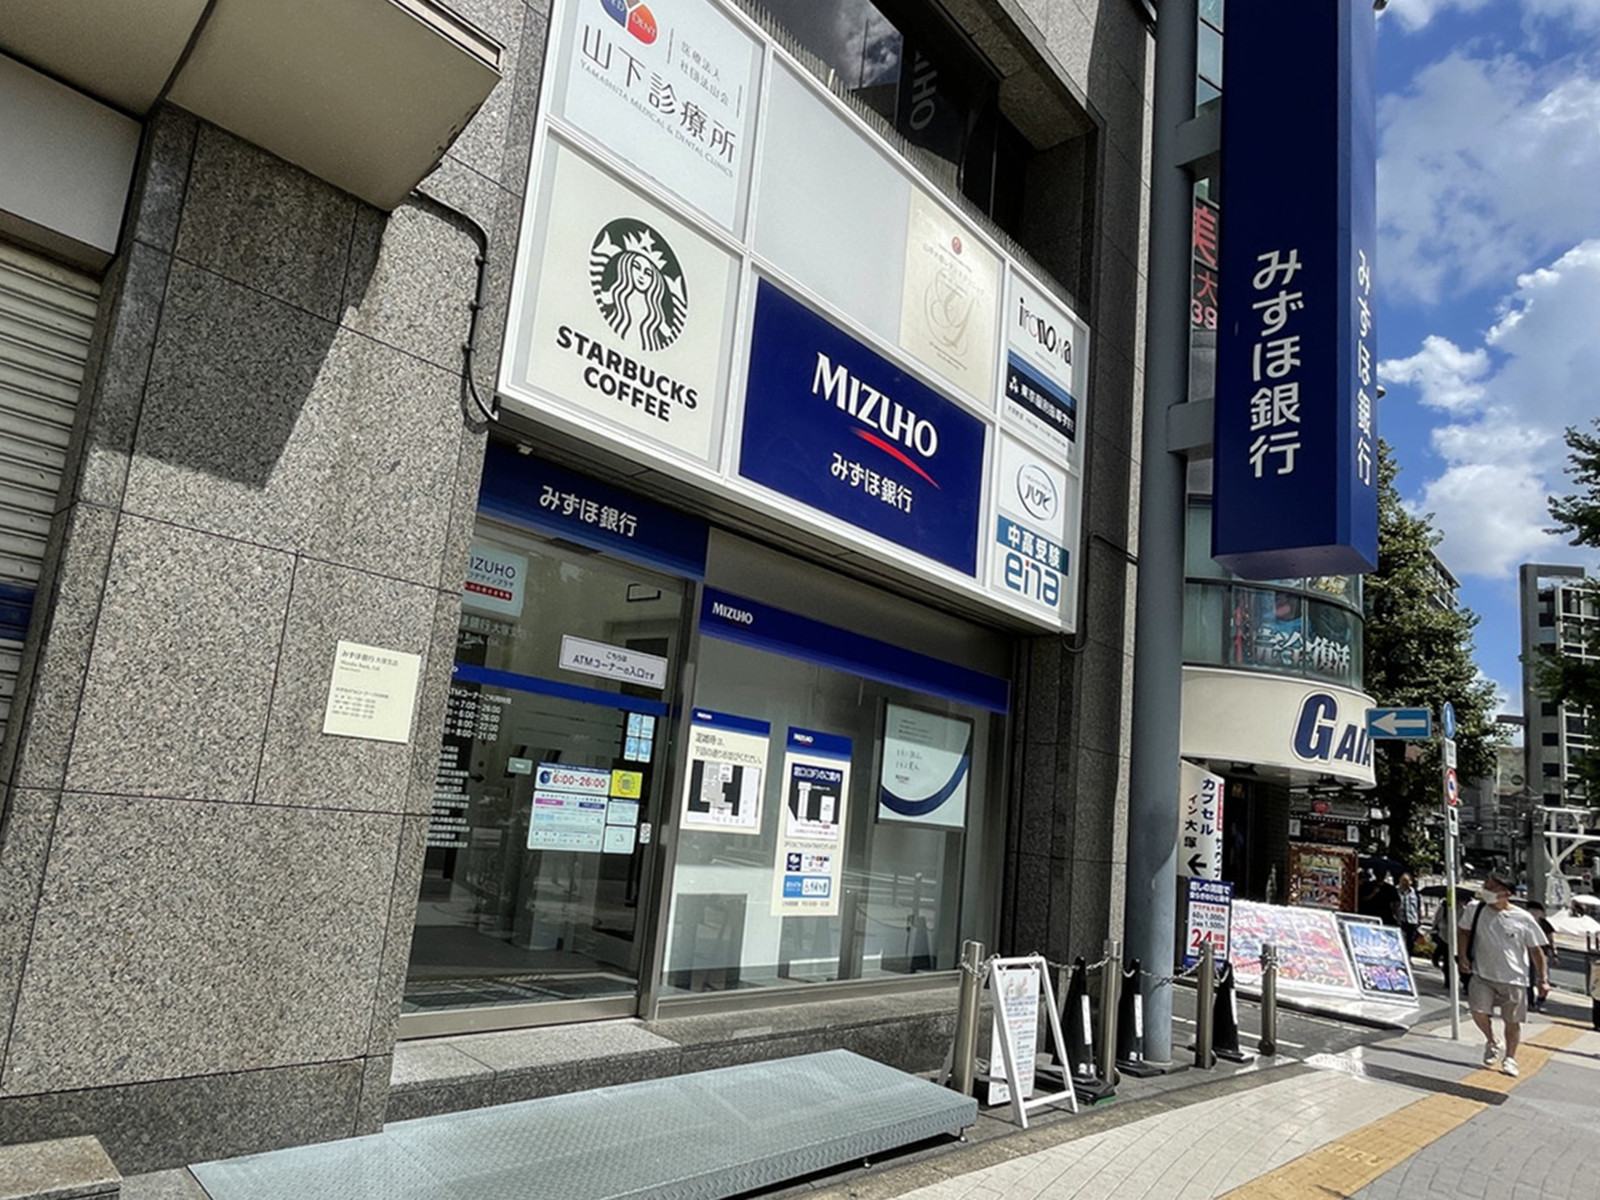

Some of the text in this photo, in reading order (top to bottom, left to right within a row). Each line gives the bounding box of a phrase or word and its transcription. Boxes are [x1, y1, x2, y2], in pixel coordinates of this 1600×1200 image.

[579, 58, 630, 103] YAMASHITA
[629, 96, 667, 132] MEDICAL
[674, 129, 704, 157] DENTAL
[582, 24, 737, 163] 山下診療所
[555, 325, 699, 410] STARBUCKS
[1249, 247, 1305, 479] みずほ銀行
[582, 366, 672, 423] COFFEE
[811, 351, 940, 458] MIZUHO
[539, 484, 639, 538] みずほ銀行
[830, 451, 914, 514] みずほ銀行
[469, 555, 517, 580] IZUHO
[1004, 551, 1060, 608] ena
[711, 601, 754, 625] MIZUHO
[572, 654, 656, 681] ATMコーナーの入口です
